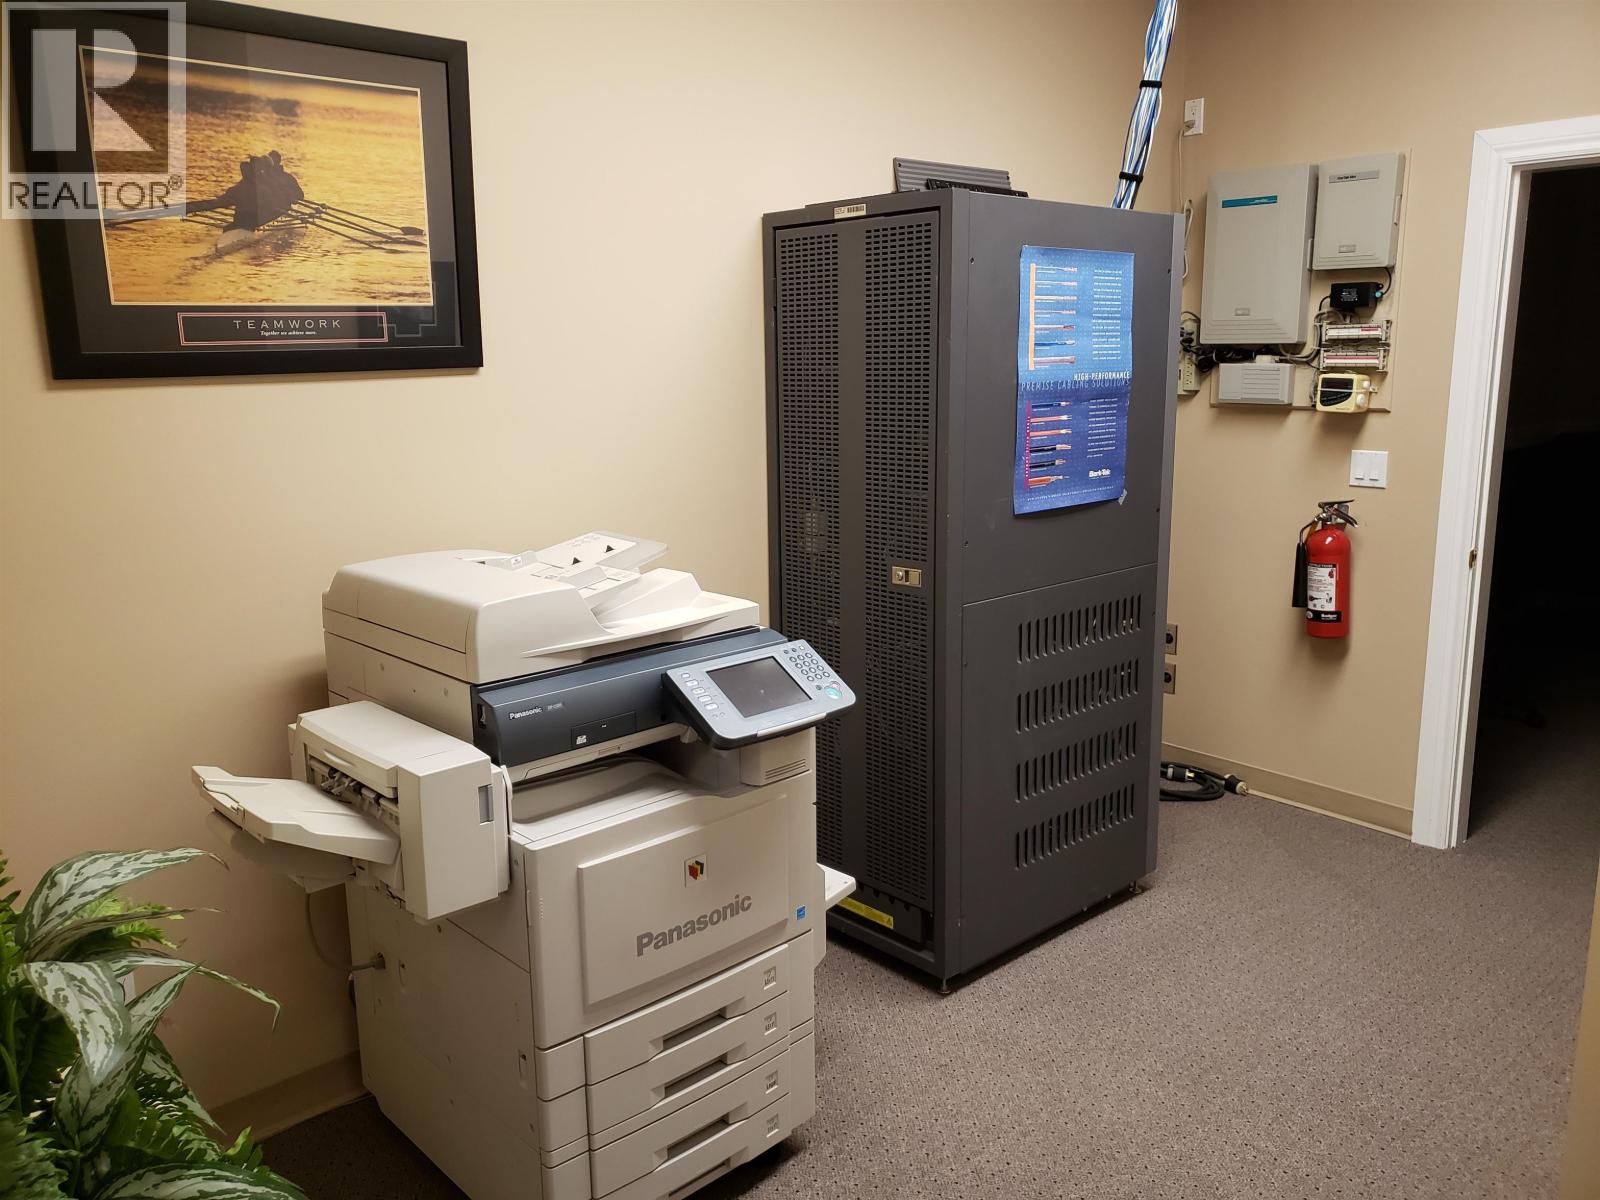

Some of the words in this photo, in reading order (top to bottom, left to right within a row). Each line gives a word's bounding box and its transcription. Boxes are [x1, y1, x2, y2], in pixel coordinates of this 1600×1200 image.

[233, 319, 341, 329] TEAMWORK
[1073, 370, 1130, 381] HIGH-PERFORMANCE
[1021, 381, 1054, 392] PREMISE
[1057, 379, 1089, 390] CABLING
[1092, 378, 1131, 388] SOLUTIONS
[509, 706, 543, 720] Panasonic
[635, 893, 753, 958] Panasonic
